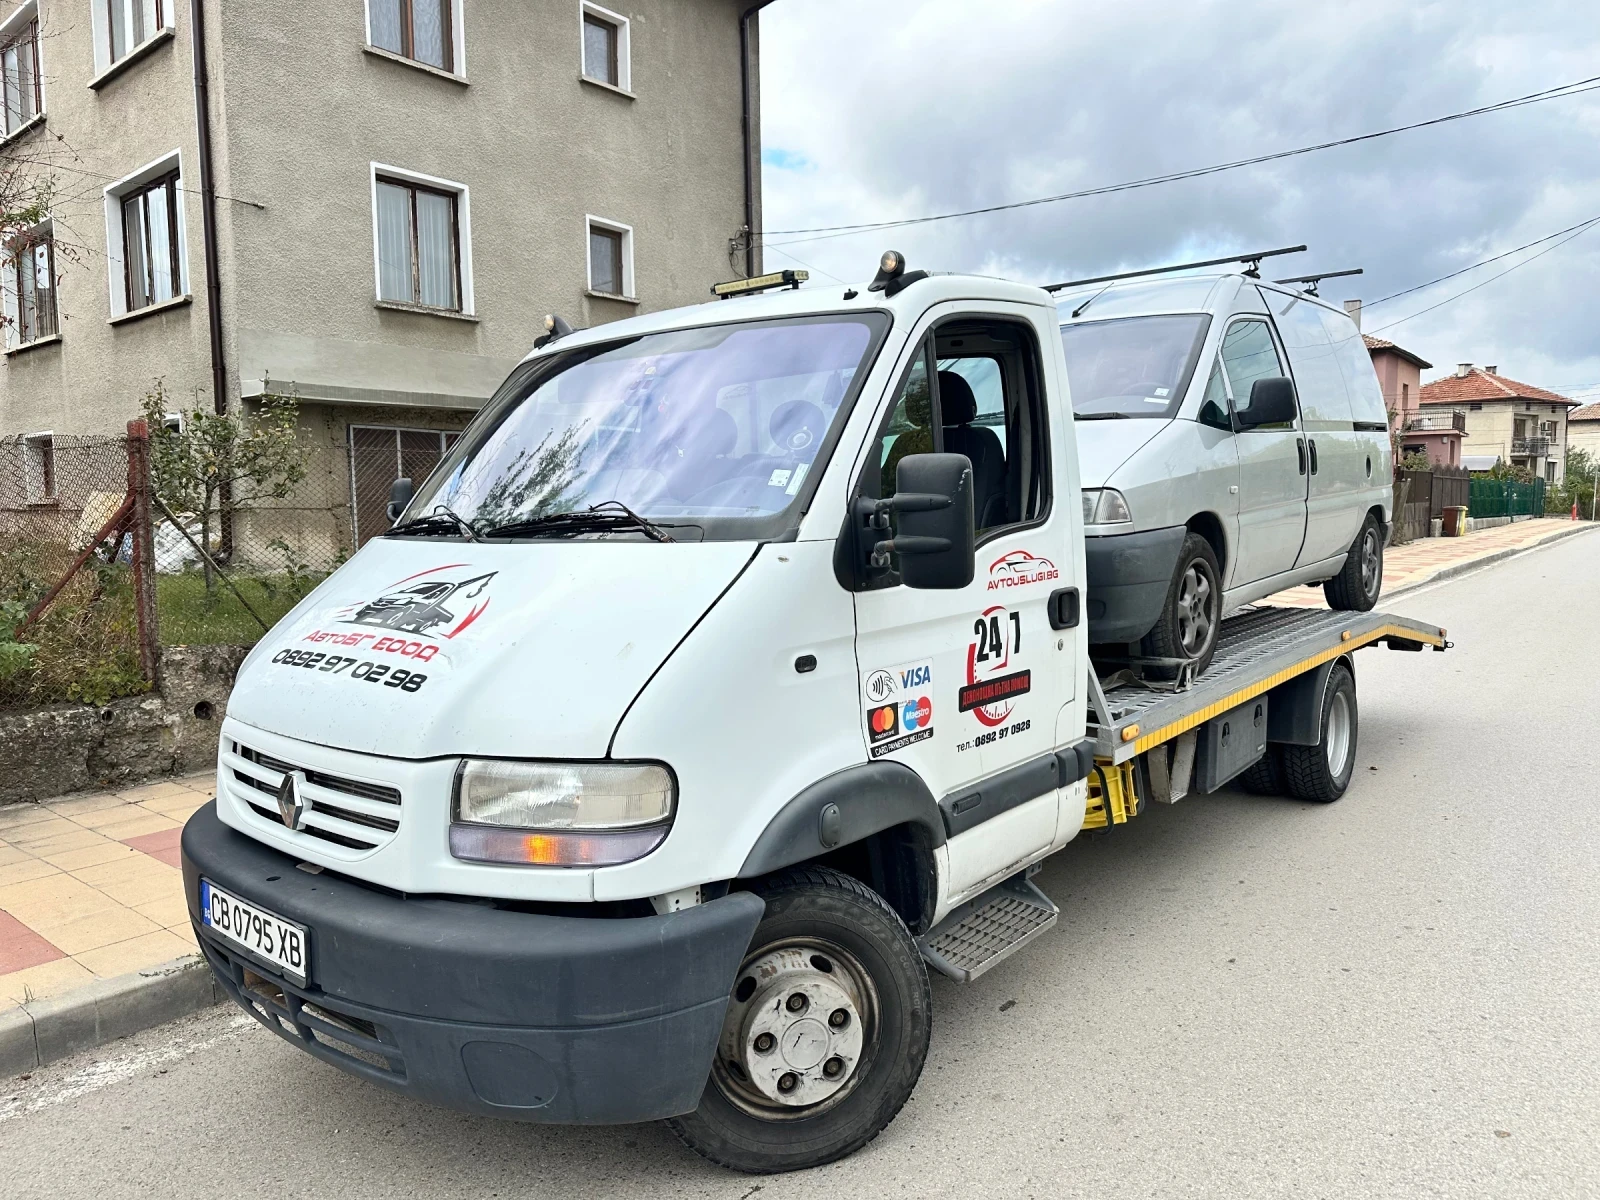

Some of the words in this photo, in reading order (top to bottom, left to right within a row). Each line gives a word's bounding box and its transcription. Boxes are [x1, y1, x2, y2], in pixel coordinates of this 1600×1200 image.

[987, 569, 1059, 591] AVTOUSLUGI.BG
[371, 637, 440, 662] ЕООД
[272, 649, 327, 669] 0892
[318, 656, 358, 674] 97
[351, 662, 391, 683] 02
[384, 669, 428, 693] 98
[900, 665, 931, 689] VISA
[905, 707, 930, 722] Maestro
[998, 726, 1009, 740] 97
[1010, 719, 1031, 736] 0928
[874, 744, 889, 756] CARD
[233, 904, 274, 954] 0795
